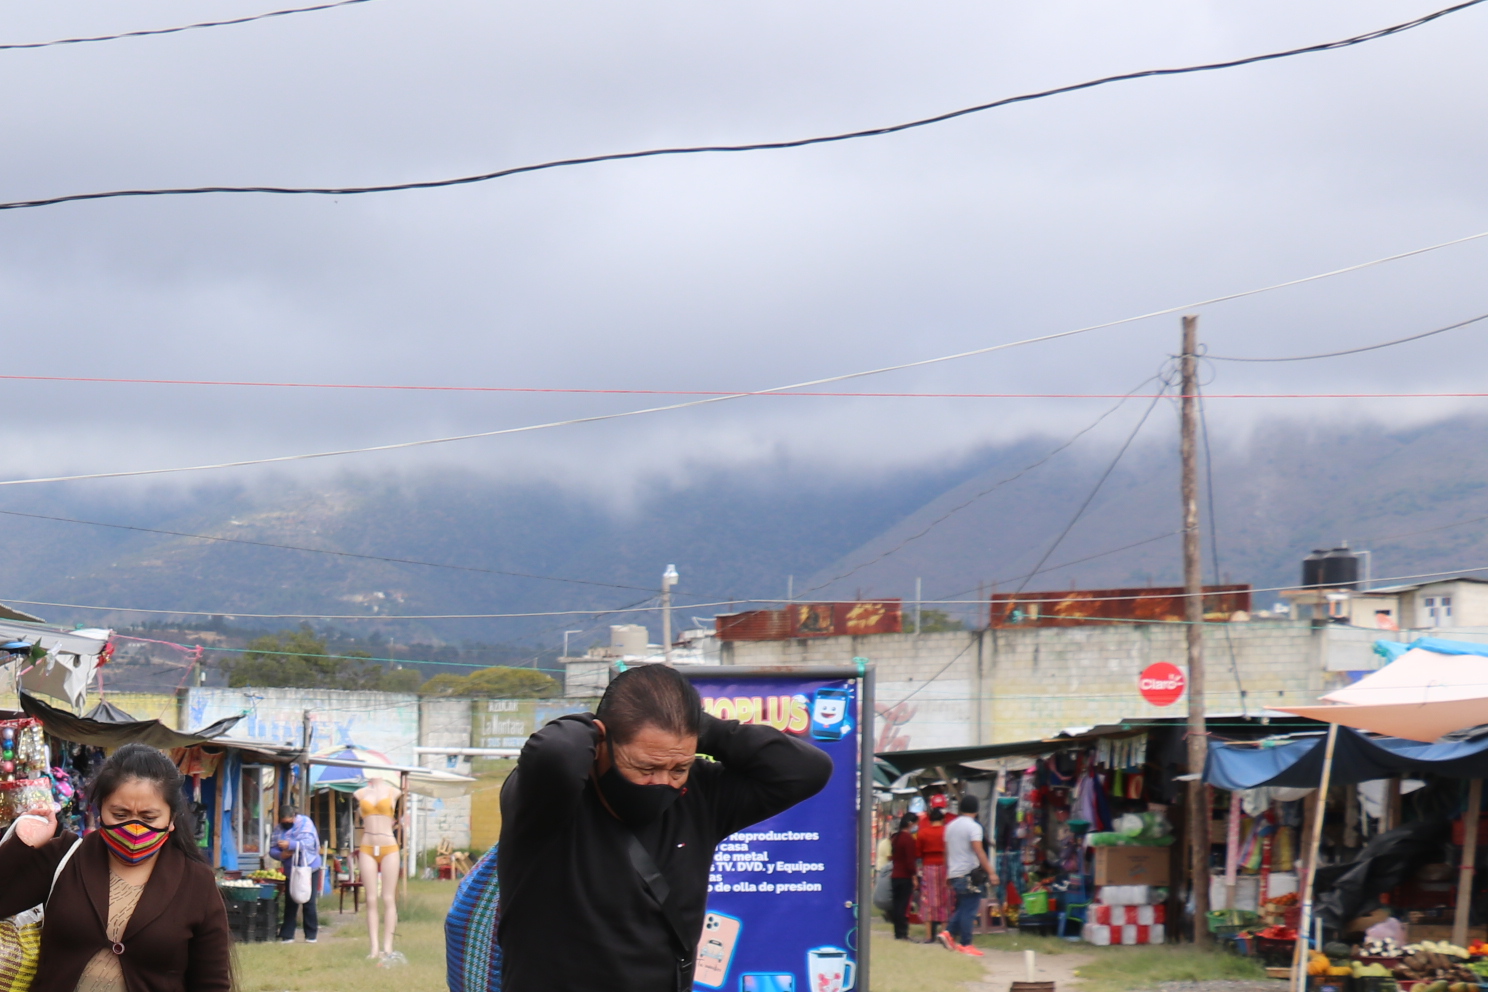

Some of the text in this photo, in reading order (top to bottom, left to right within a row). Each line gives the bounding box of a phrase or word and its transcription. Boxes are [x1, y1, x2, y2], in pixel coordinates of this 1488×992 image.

[1140, 678, 1177, 690] Claro
[729, 831, 820, 844] Reproductores
[719, 843, 749, 852] casa
[714, 851, 769, 862] de metal
[716, 861, 735, 872] TV.
[736, 861, 766, 872] DVD.
[766, 863, 775, 874] y
[776, 861, 825, 874] Equipos
[714, 882, 731, 892] de
[732, 882, 758, 893] olla
[758, 881, 774, 892] de
[775, 881, 822, 894] presion
